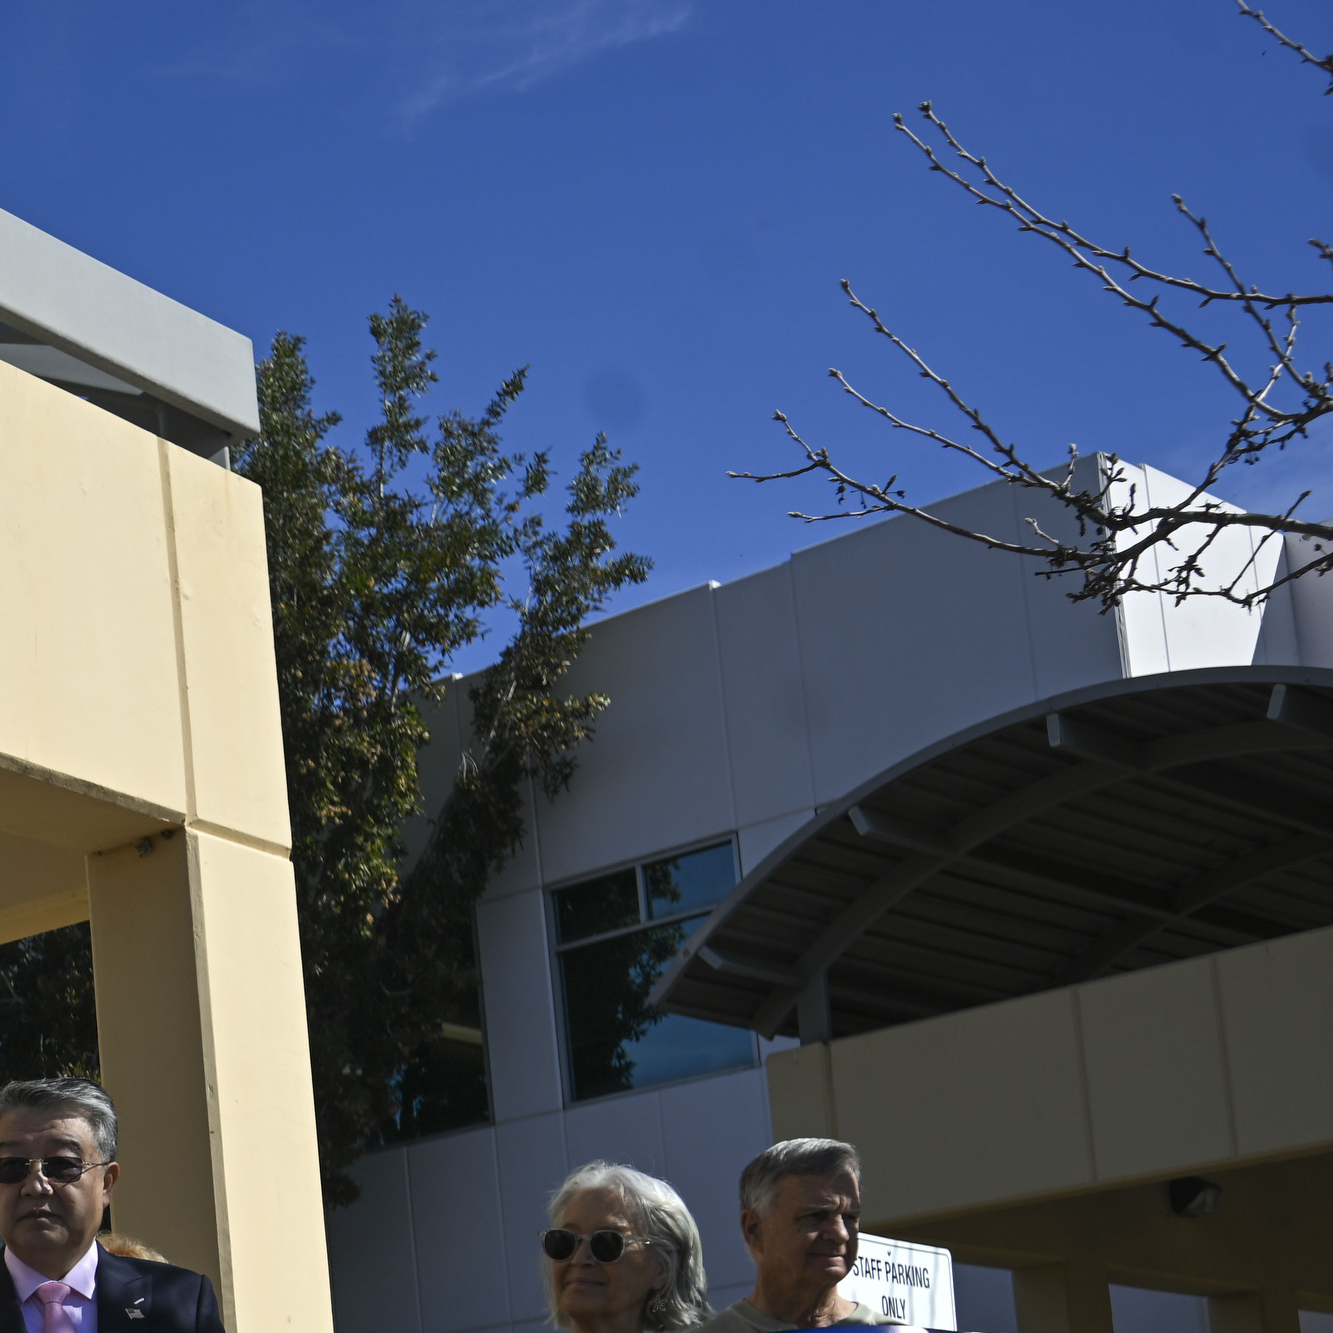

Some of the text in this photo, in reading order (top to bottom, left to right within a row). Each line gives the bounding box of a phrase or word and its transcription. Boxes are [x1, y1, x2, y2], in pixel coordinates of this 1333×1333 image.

[853, 1256, 930, 1288] STAFF PARKING
[881, 1295, 906, 1320] ONLY
